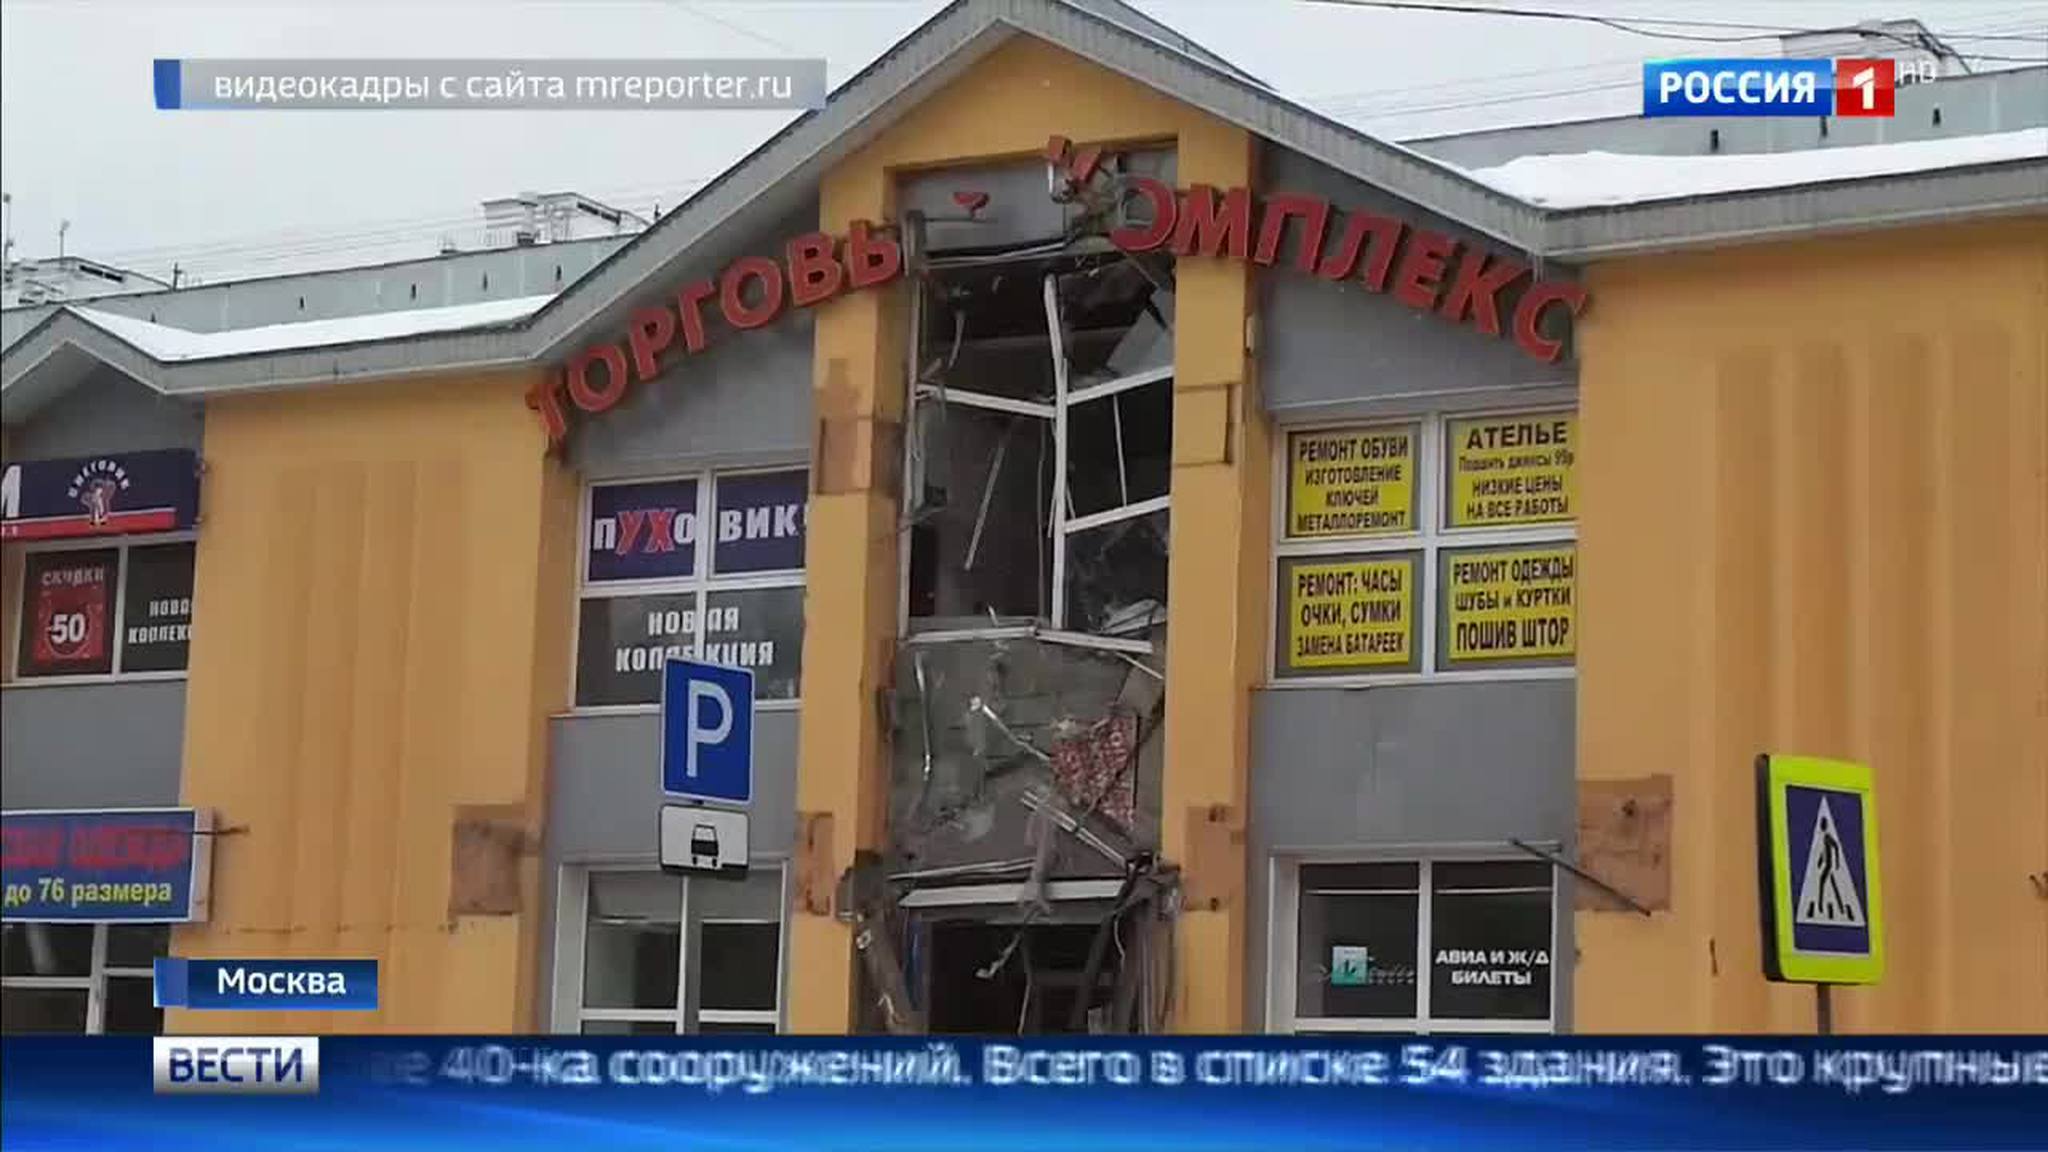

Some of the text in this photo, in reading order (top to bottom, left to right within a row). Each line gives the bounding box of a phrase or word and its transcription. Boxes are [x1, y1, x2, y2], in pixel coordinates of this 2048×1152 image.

[1467, 422, 1567, 449] АТЕЛЬЕ
[1300, 435, 1408, 461] РЕМОНТ ОБУВИ
[1305, 464, 1402, 487] ИЗГОТОВЛЕНИЕ
[1473, 474, 1562, 496] НИЗКИЕ ЦЕНЫ
[1325, 488, 1379, 507] КЛЮЧЕЙ
[1467, 496, 1569, 518] НА ВСЕ РАБОТЫ
[1298, 511, 1405, 532] МЕТАЛЛОРЕМОНТ
[1454, 556, 1573, 584] РЕМОНТ ОДЕЖДЫ
[1298, 569, 1402, 598] РЕМОНТ: ЧАСЫ
[1456, 590, 1499, 611] ШУБЫ
[1516, 587, 1571, 608] КУРТКИ
[1301, 600, 1401, 628] ОЧКИ, СУМКИ
[1297, 632, 1404, 656] ЗАМЕНА БАТАРЕЕК
[1457, 617, 1569, 650] ПОШИВ ШТОР
[687, 680, 733, 777] P
[4, 877, 172, 908] до 76 размера
[1436, 950, 1549, 967] АВИА И Ж/Д
[1452, 971, 1531, 985] БИЛЕТЫ
